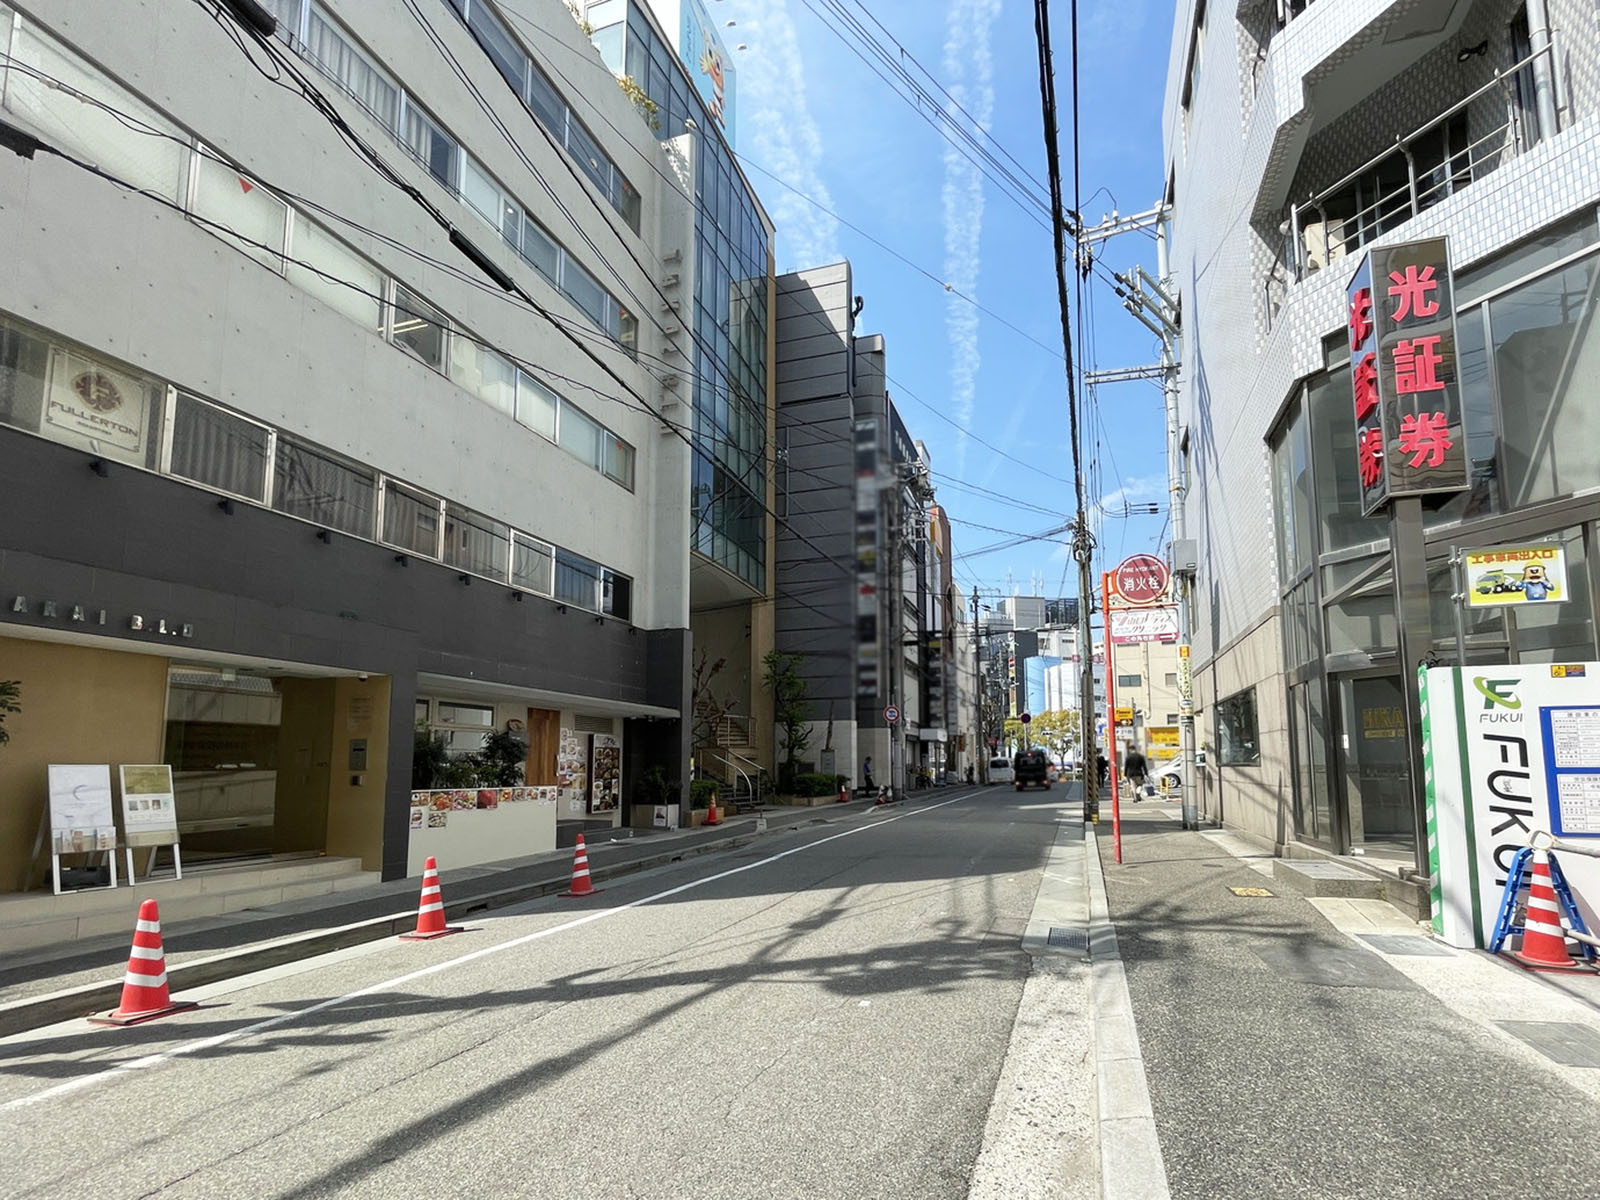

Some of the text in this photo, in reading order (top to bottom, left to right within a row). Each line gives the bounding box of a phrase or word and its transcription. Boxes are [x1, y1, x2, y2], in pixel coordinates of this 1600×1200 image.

[1387, 264, 1453, 469] 光証券
[51, 400, 139, 437] FULLERTON
[1471, 549, 1554, 564] 工事車両出入口
[1123, 575, 1160, 592] 消火栓
[13, 595, 107, 625] ARAI
[1479, 713, 1523, 724] FUKUI
